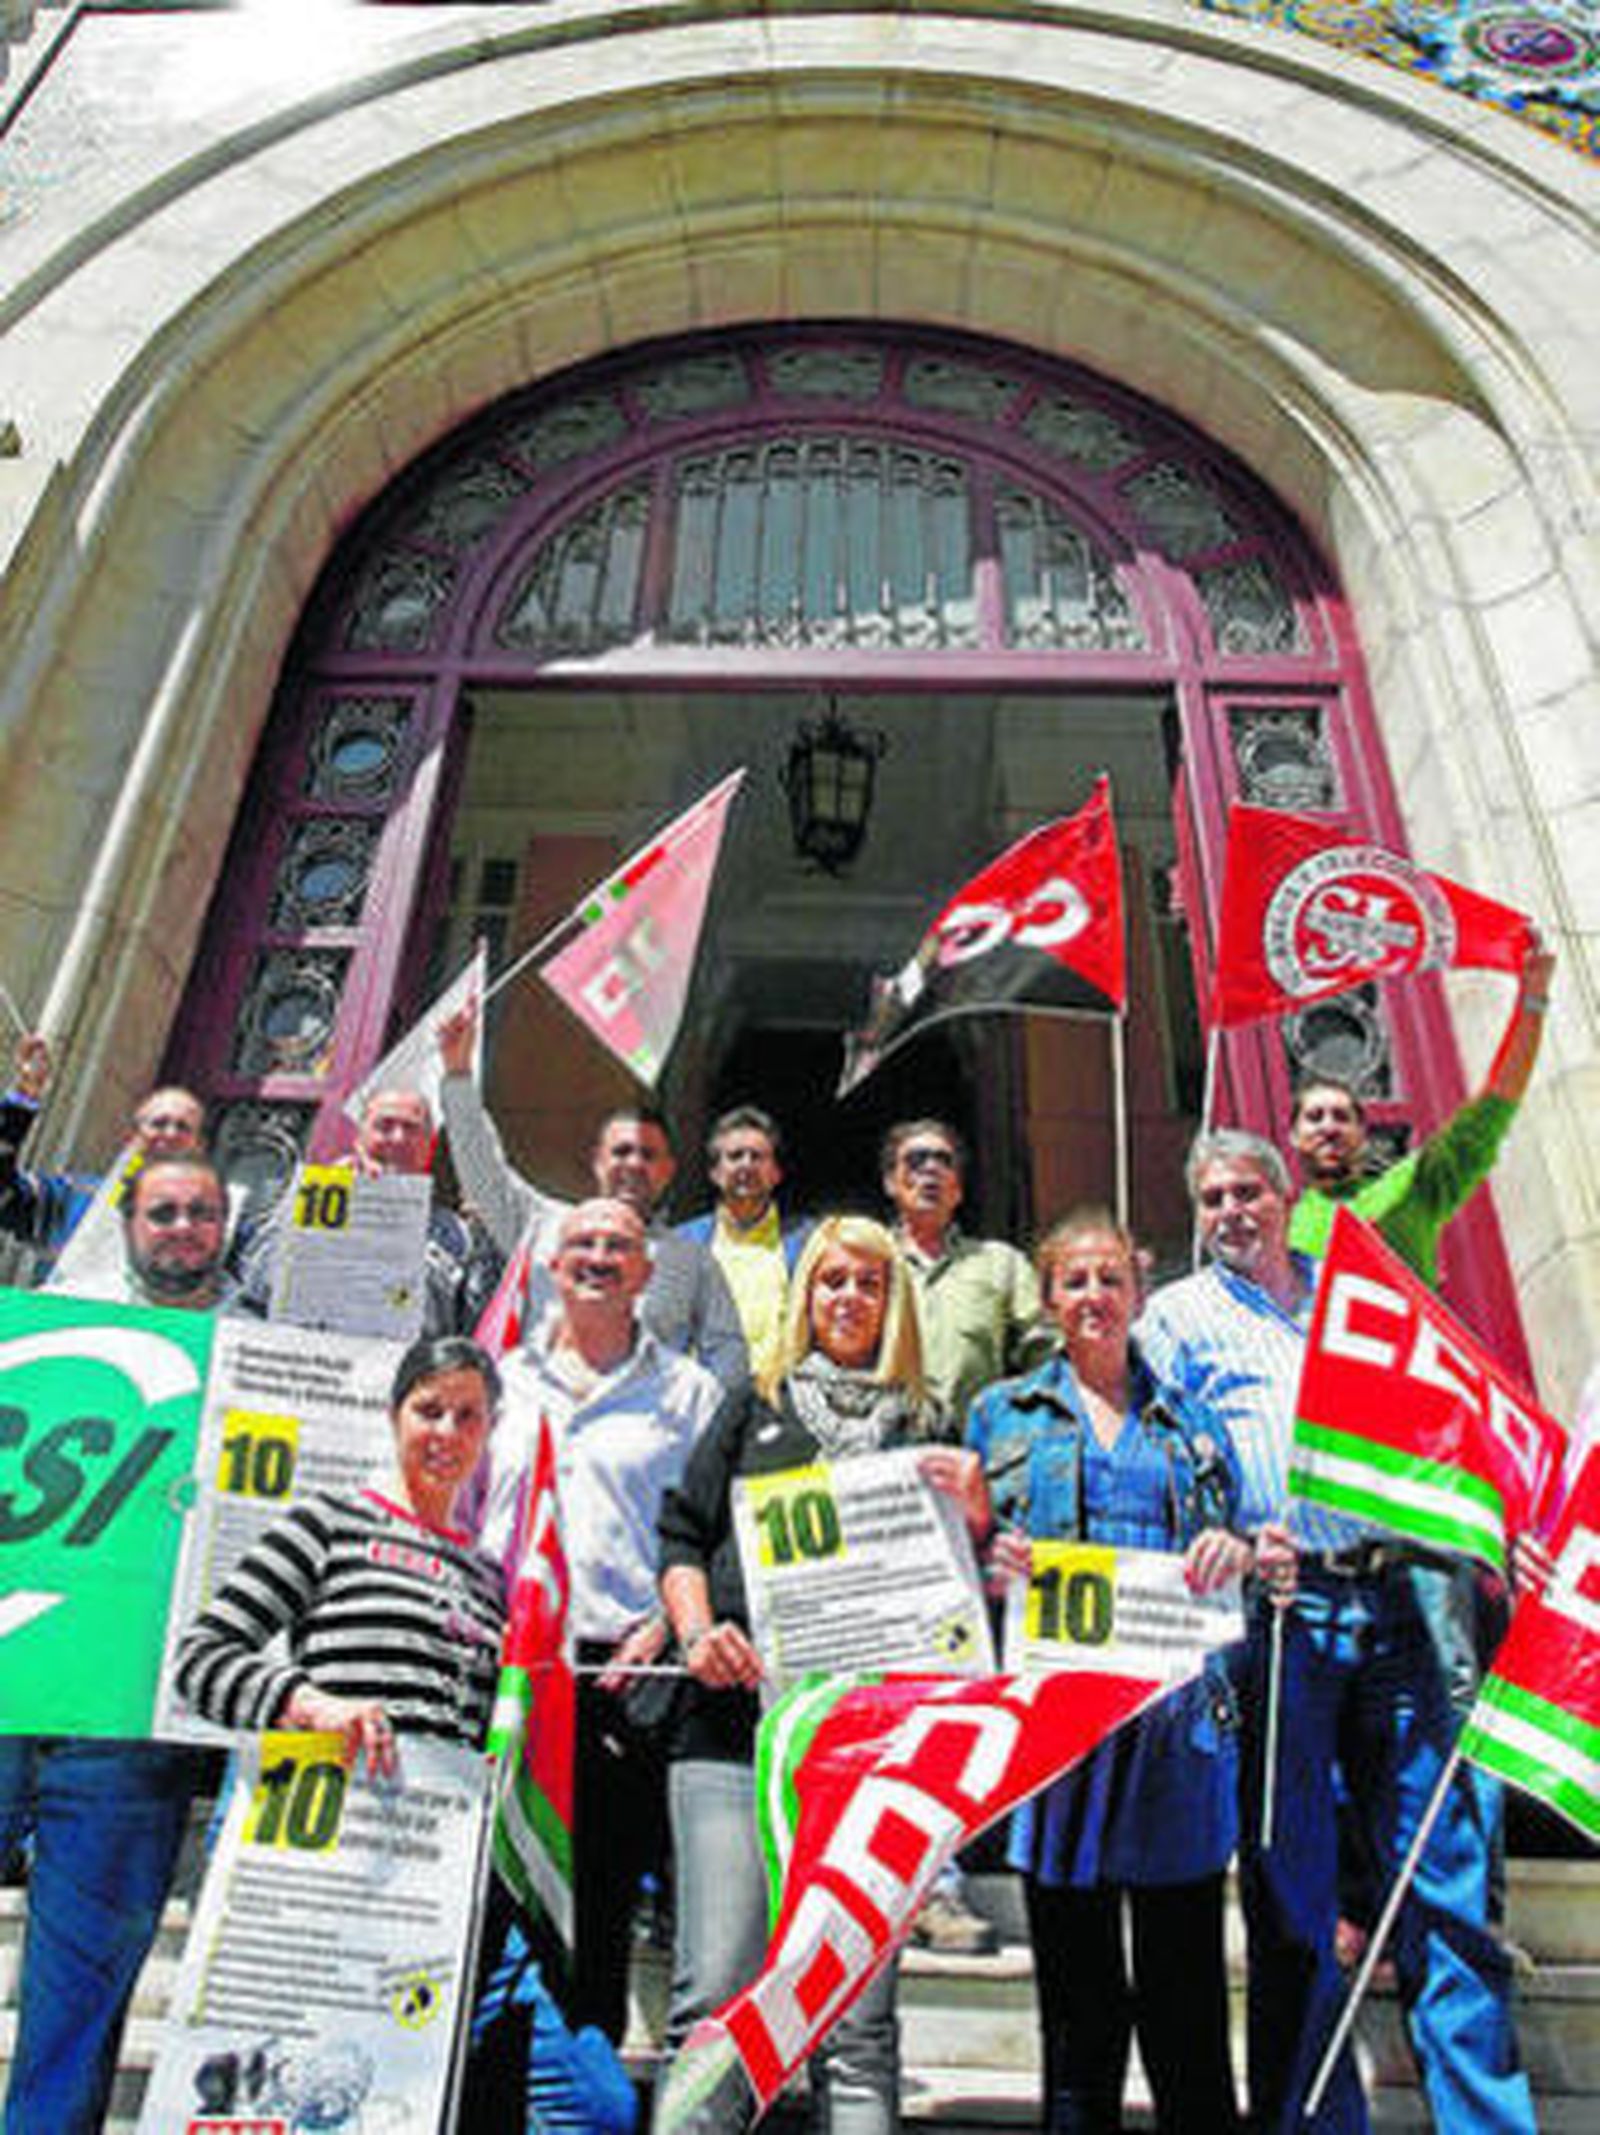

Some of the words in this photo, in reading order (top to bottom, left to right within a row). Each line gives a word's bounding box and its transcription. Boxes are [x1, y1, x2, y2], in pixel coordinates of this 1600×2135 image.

[298, 1183, 348, 1228] 10
[223, 1432, 292, 1498] 10
[756, 1490, 841, 1564] 10
[1030, 1567, 1114, 1647] 10
[255, 1757, 348, 1850] 10
